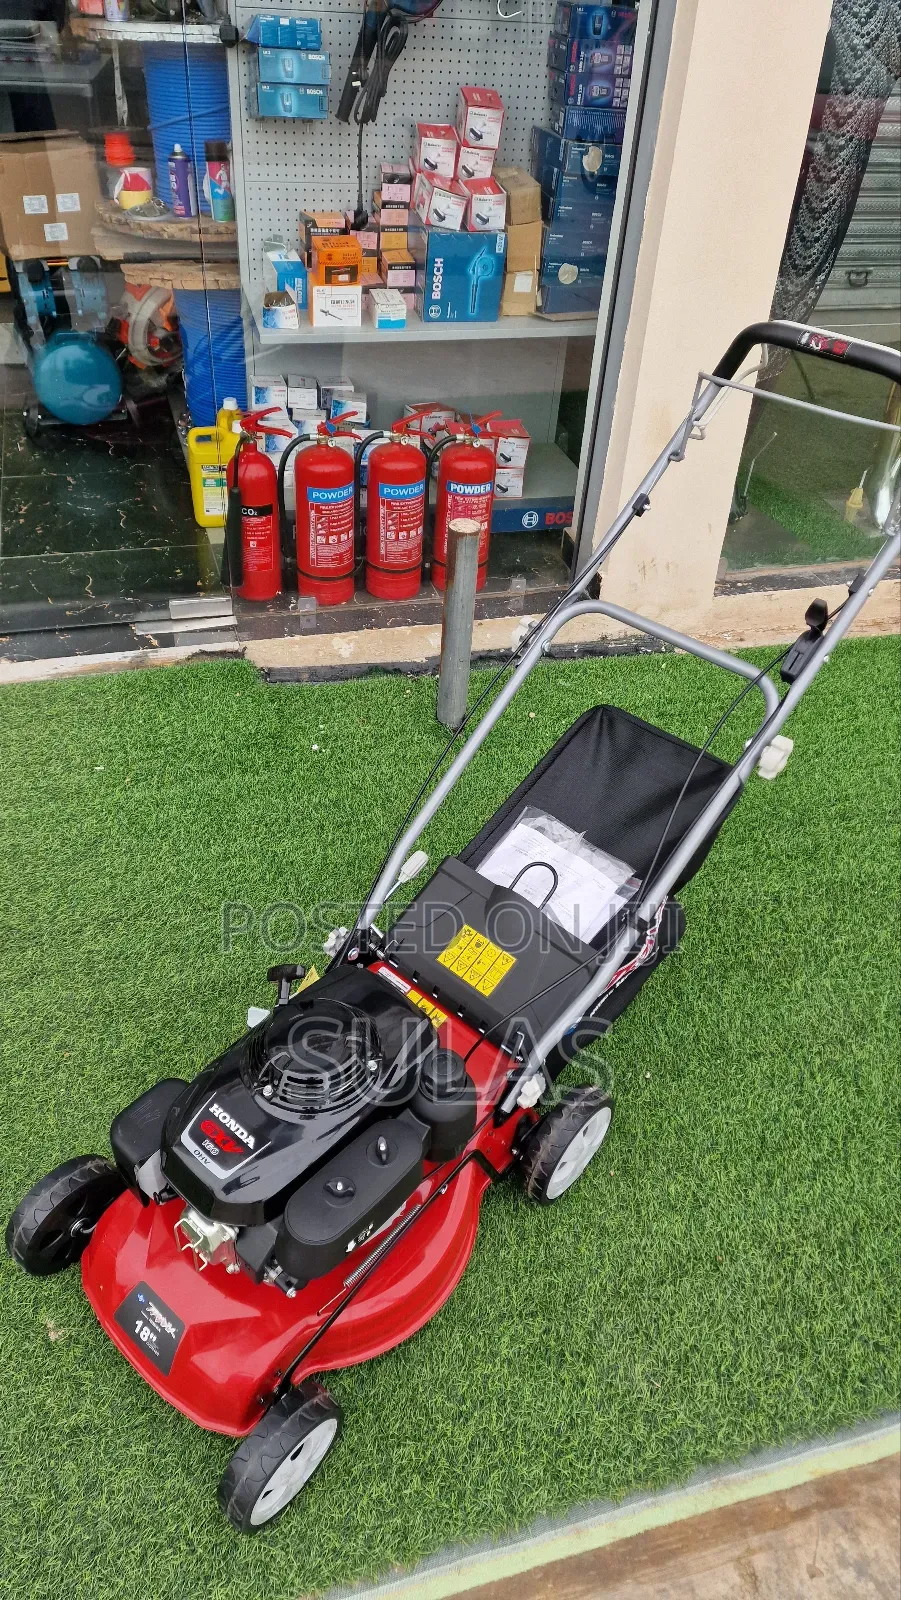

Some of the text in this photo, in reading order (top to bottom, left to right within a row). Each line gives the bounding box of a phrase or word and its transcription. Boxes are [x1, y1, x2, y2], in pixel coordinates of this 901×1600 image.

[431, 257, 444, 299] BOSCH
[312, 486, 353, 500] POWDER
[383, 483, 424, 496] POWDER
[450, 482, 491, 495] POWDER
[208, 1103, 256, 1150] HONDA
[193, 1149, 211, 1165] OHV
